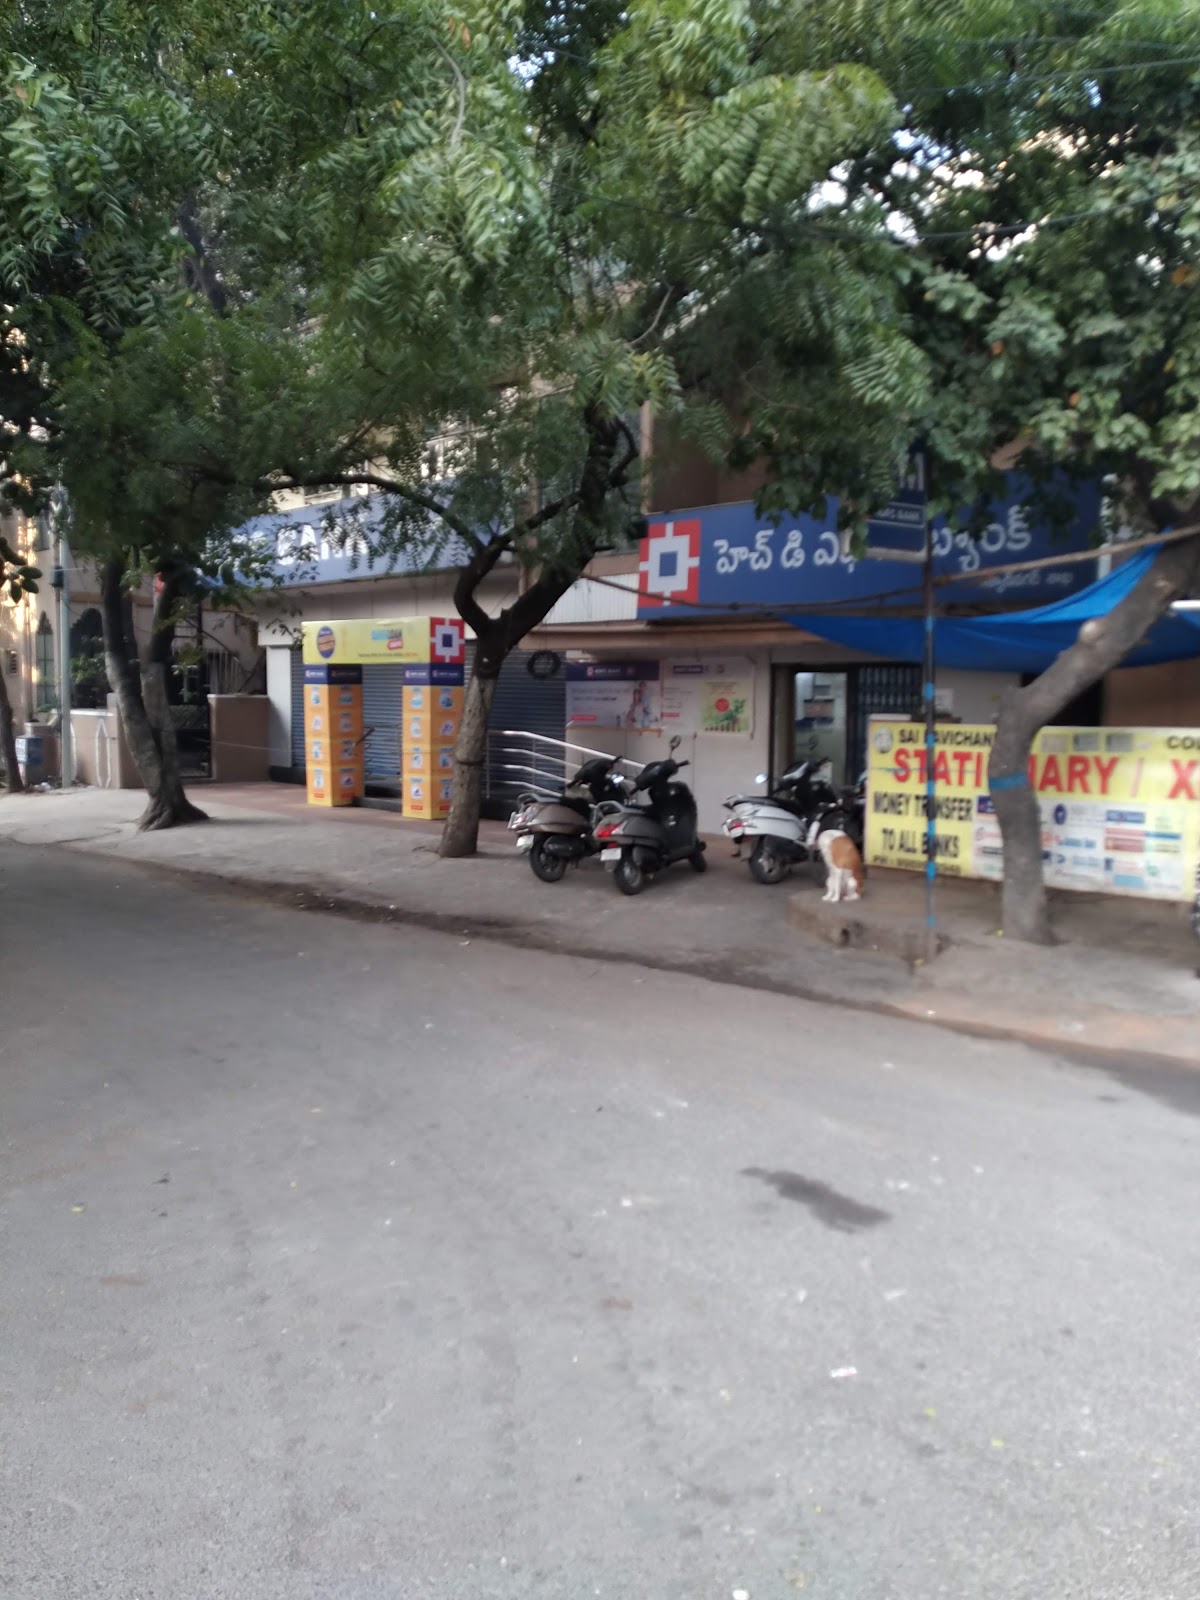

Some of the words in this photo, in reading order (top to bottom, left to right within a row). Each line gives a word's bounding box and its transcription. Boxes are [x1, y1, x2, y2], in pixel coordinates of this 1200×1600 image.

[899, 729, 919, 743] SAI
[873, 791, 911, 816] MONEY
[914, 794, 973, 821] TRNSFER
[882, 828, 895, 850] TO
[898, 830, 917, 853] ALL
[921, 832, 959, 858] BNKS
